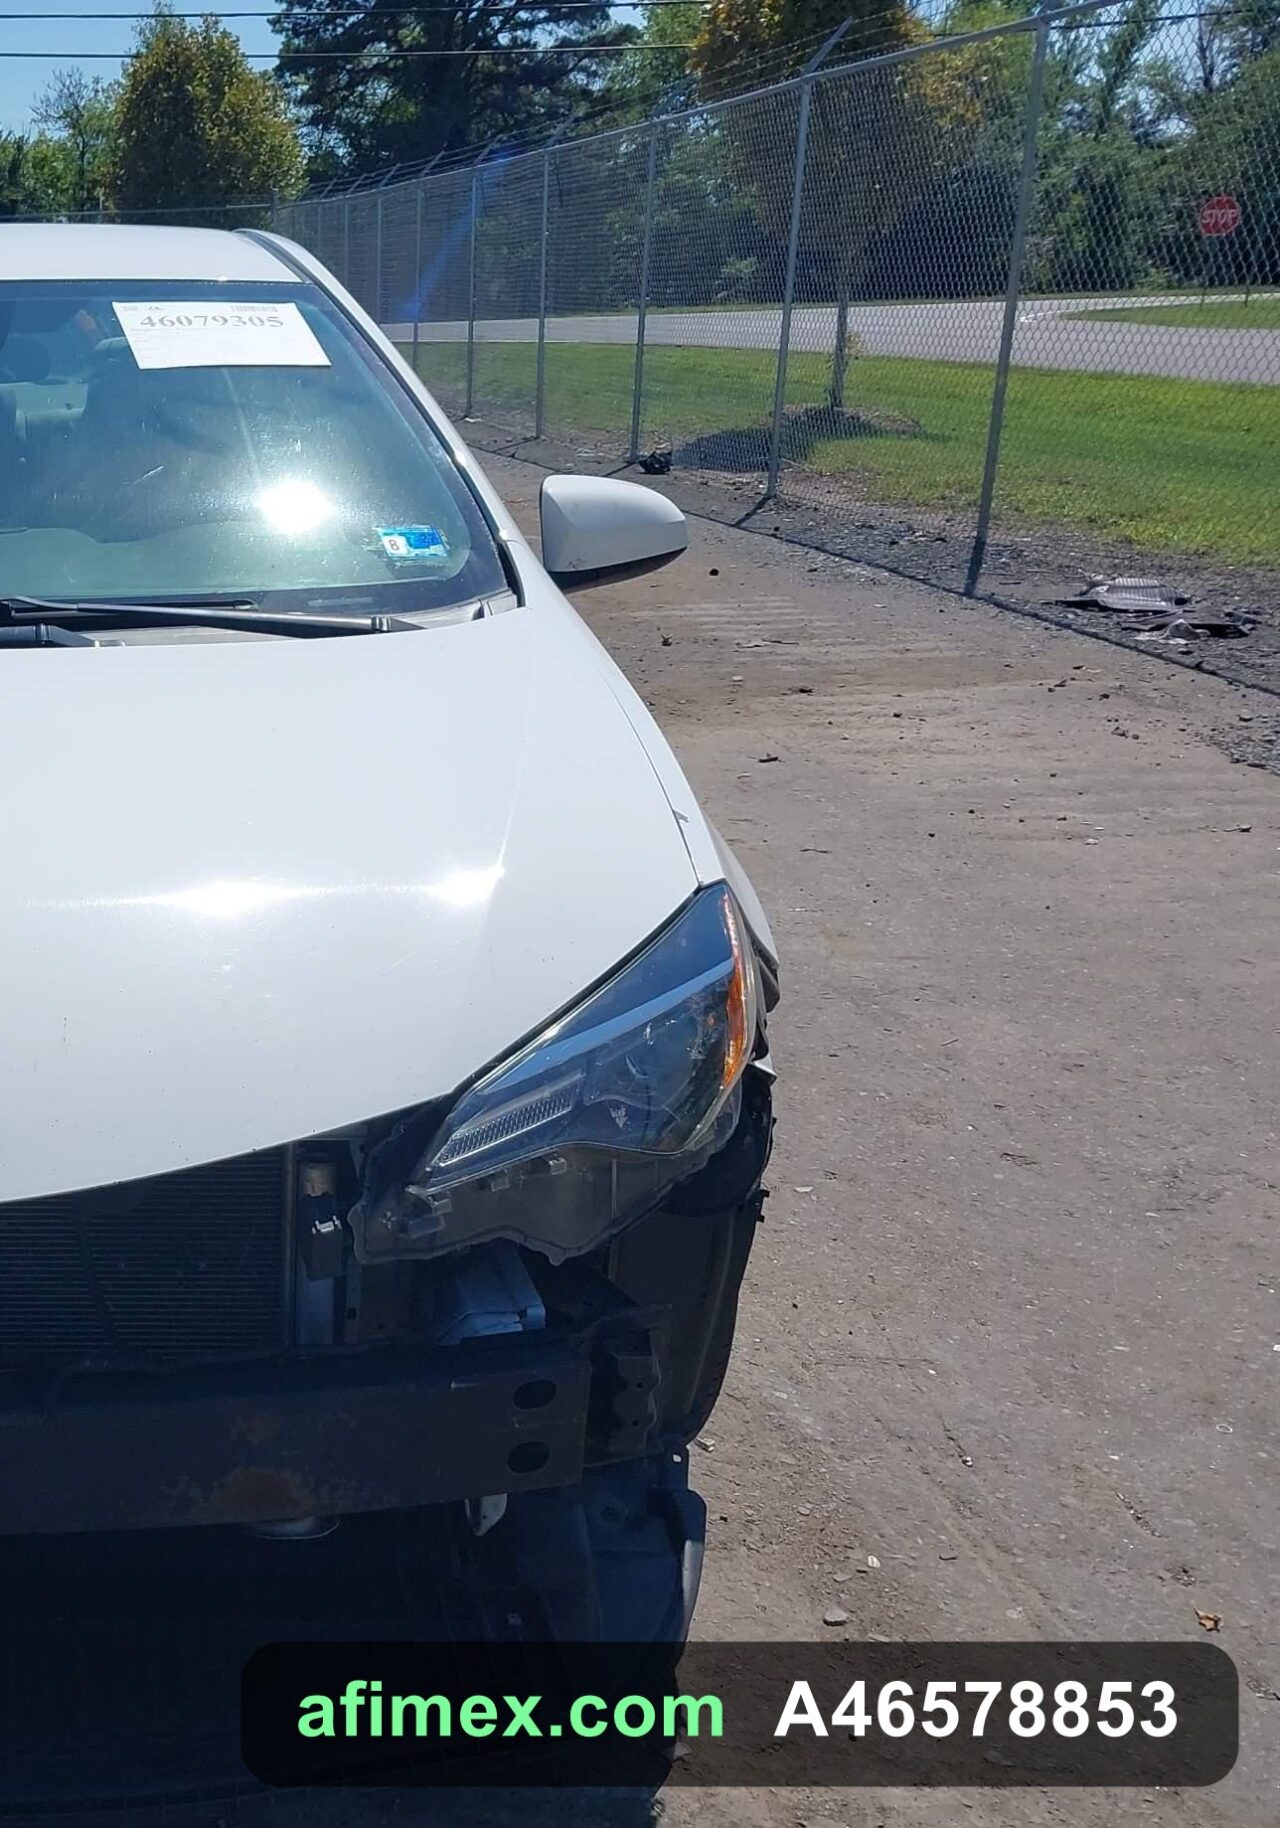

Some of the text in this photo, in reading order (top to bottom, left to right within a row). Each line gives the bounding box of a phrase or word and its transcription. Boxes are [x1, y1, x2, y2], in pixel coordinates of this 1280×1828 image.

[1202, 208, 1238, 225] STOP
[140, 314, 284, 328] 46079305
[388, 538, 400, 551] 8
